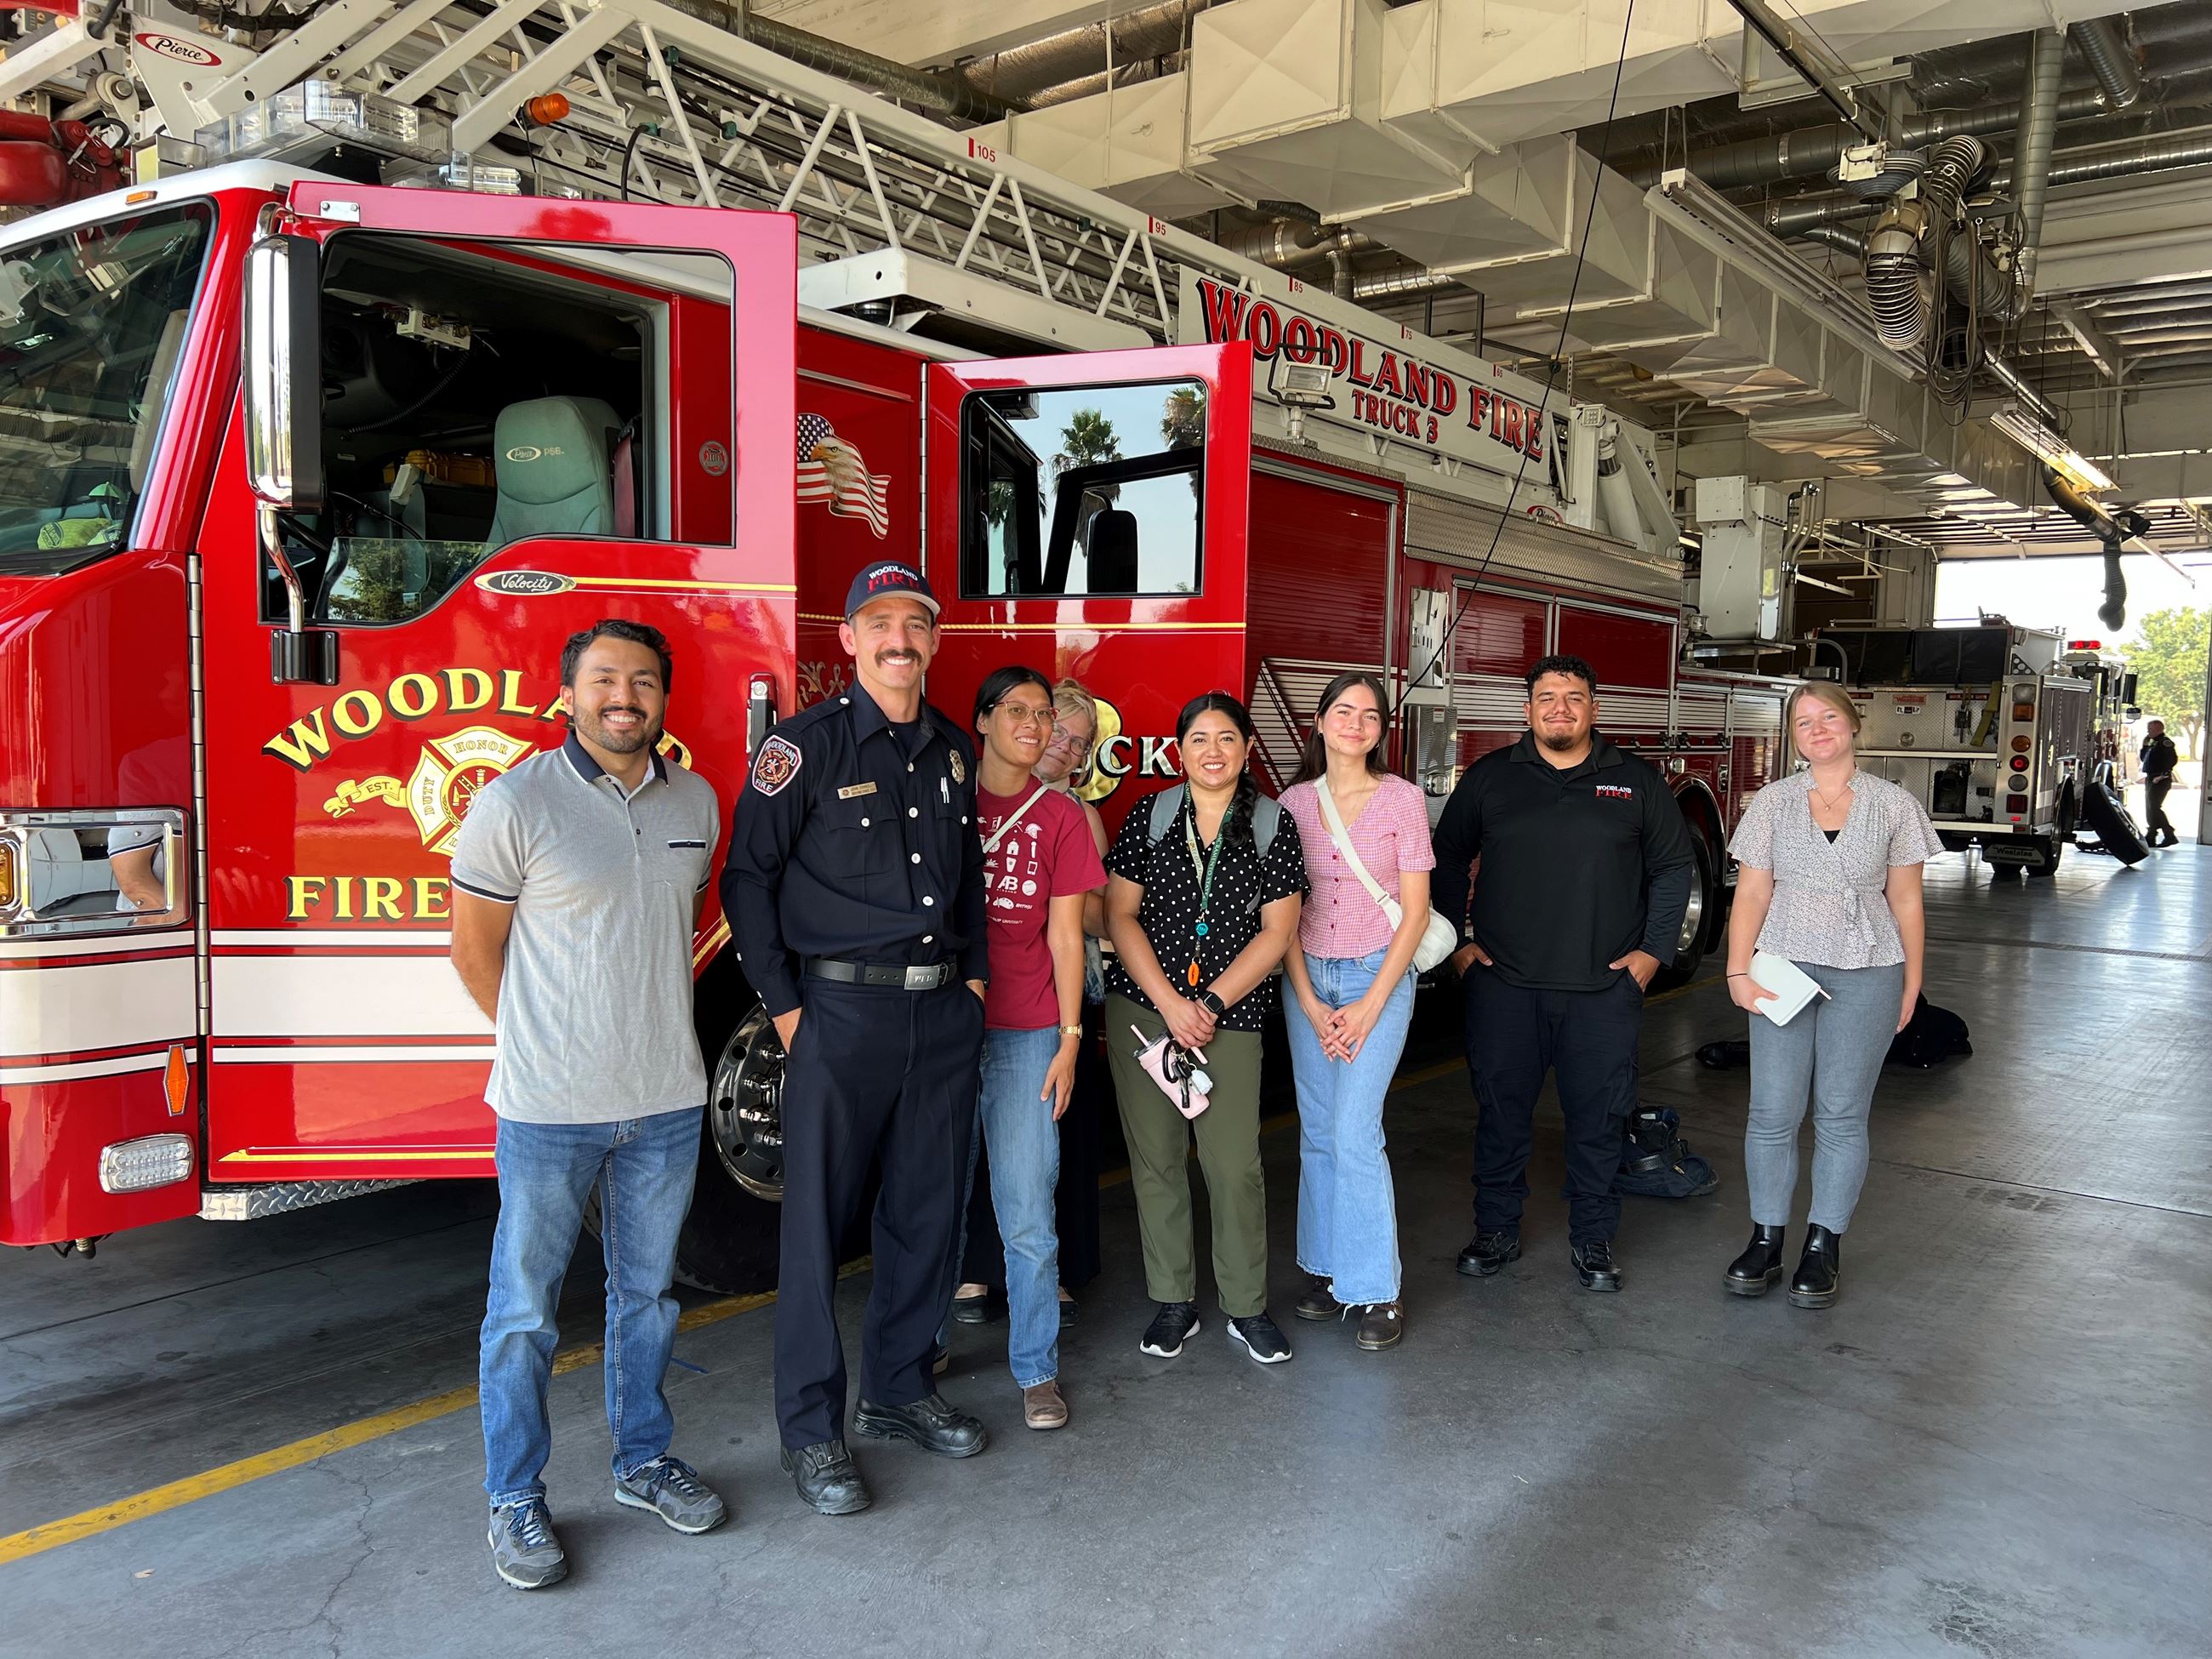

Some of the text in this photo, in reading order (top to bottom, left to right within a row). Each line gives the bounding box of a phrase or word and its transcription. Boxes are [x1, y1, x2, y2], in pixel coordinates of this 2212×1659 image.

[155, 37, 202, 60] Pierce
[978, 145, 995, 162] 105
[1155, 221, 1166, 236] 95
[1294, 281, 1303, 294] 85
[1405, 329, 1412, 340] 75
[1195, 276, 1544, 464] WOODLAND FIRE
[1351, 389, 1439, 446] TRUCK 3
[869, 565, 918, 581] WOODLAND
[501, 573, 553, 592] Velocity
[453, 739, 509, 755] HONOR
[366, 781, 393, 793] EST.
[755, 778, 773, 791] FIRE
[1595, 785, 1632, 794] WOODLAND
[424, 776, 436, 816] DUTY
[1207, 834, 1223, 878] SACRAMENTO
[284, 875, 452, 923] FIRE
